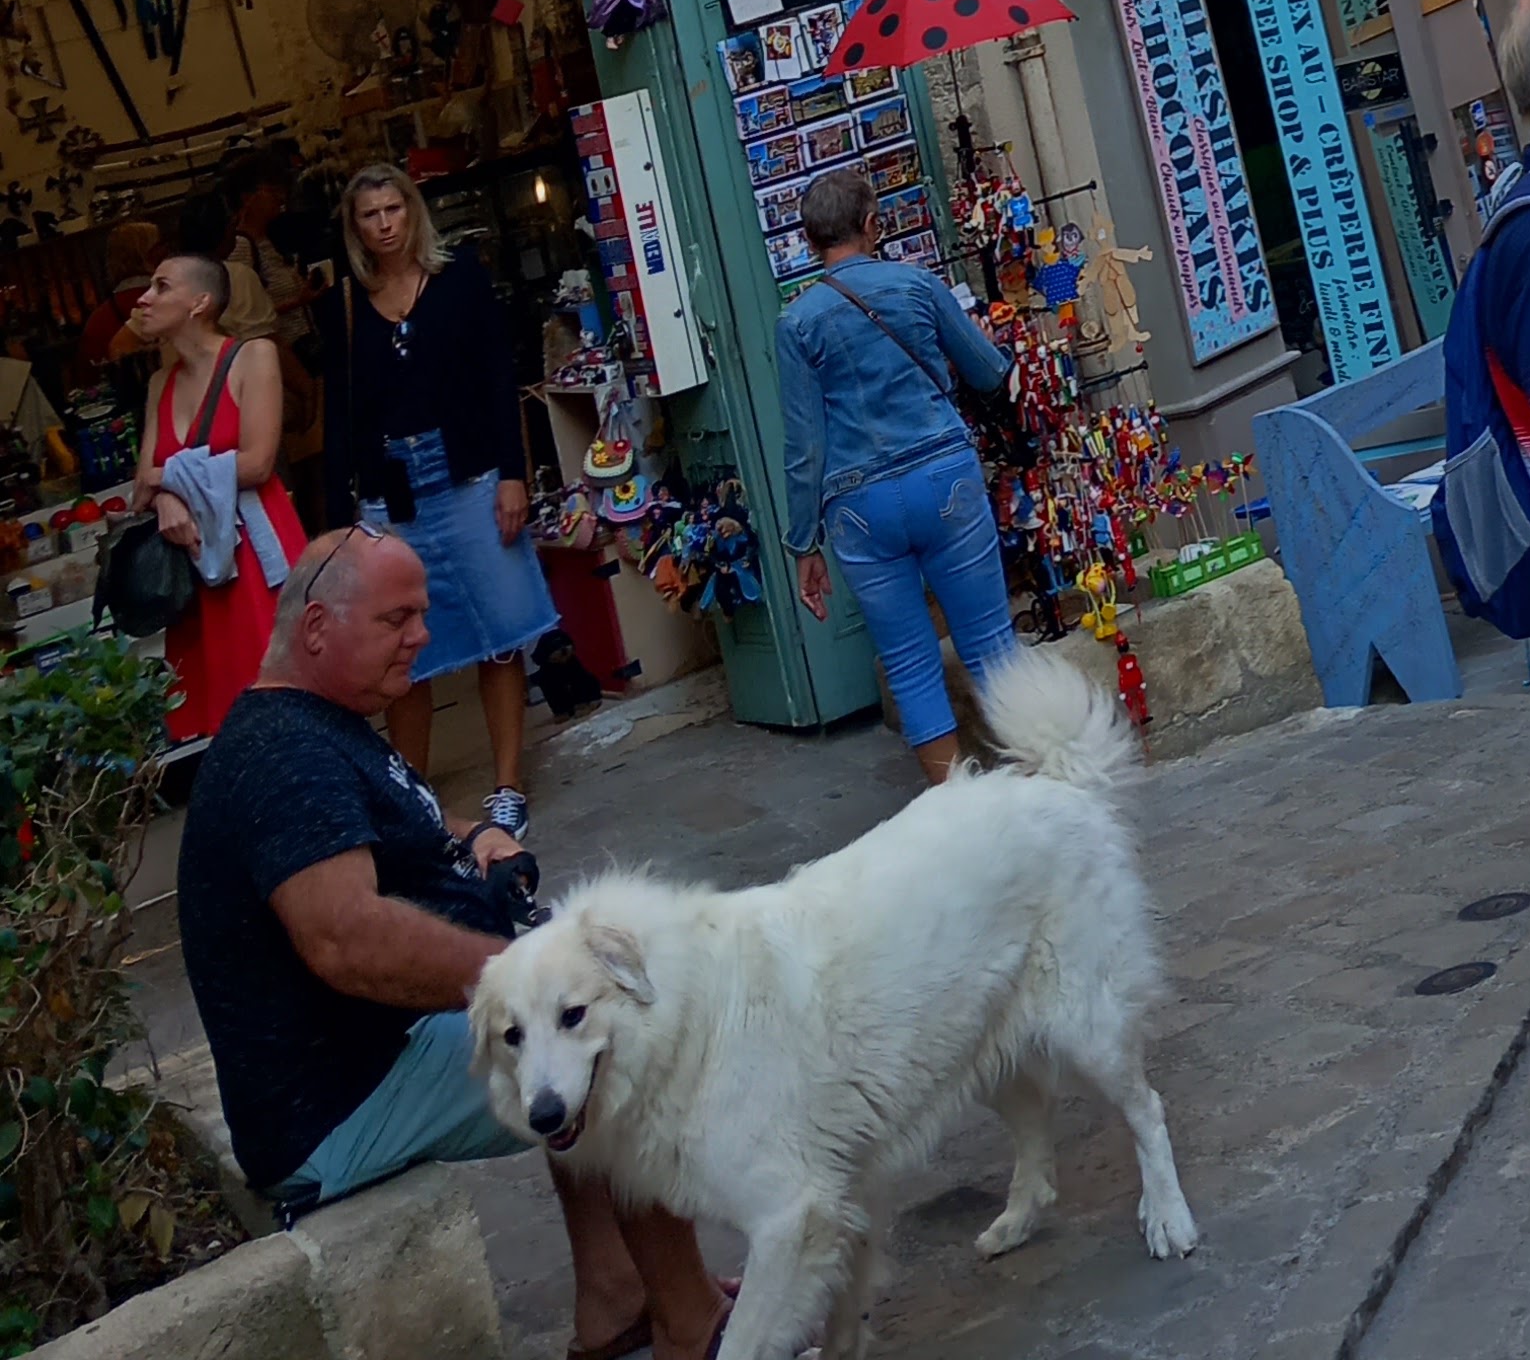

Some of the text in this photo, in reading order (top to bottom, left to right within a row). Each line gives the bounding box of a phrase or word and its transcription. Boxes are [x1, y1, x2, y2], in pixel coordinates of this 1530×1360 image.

[1266, 54, 1304, 145] SHOP
[1289, 152, 1313, 179] &
[1298, 43, 1328, 85] AU
[1318, 123, 1376, 293] CRÊPERIE
[1296, 184, 1335, 271] PLUS
